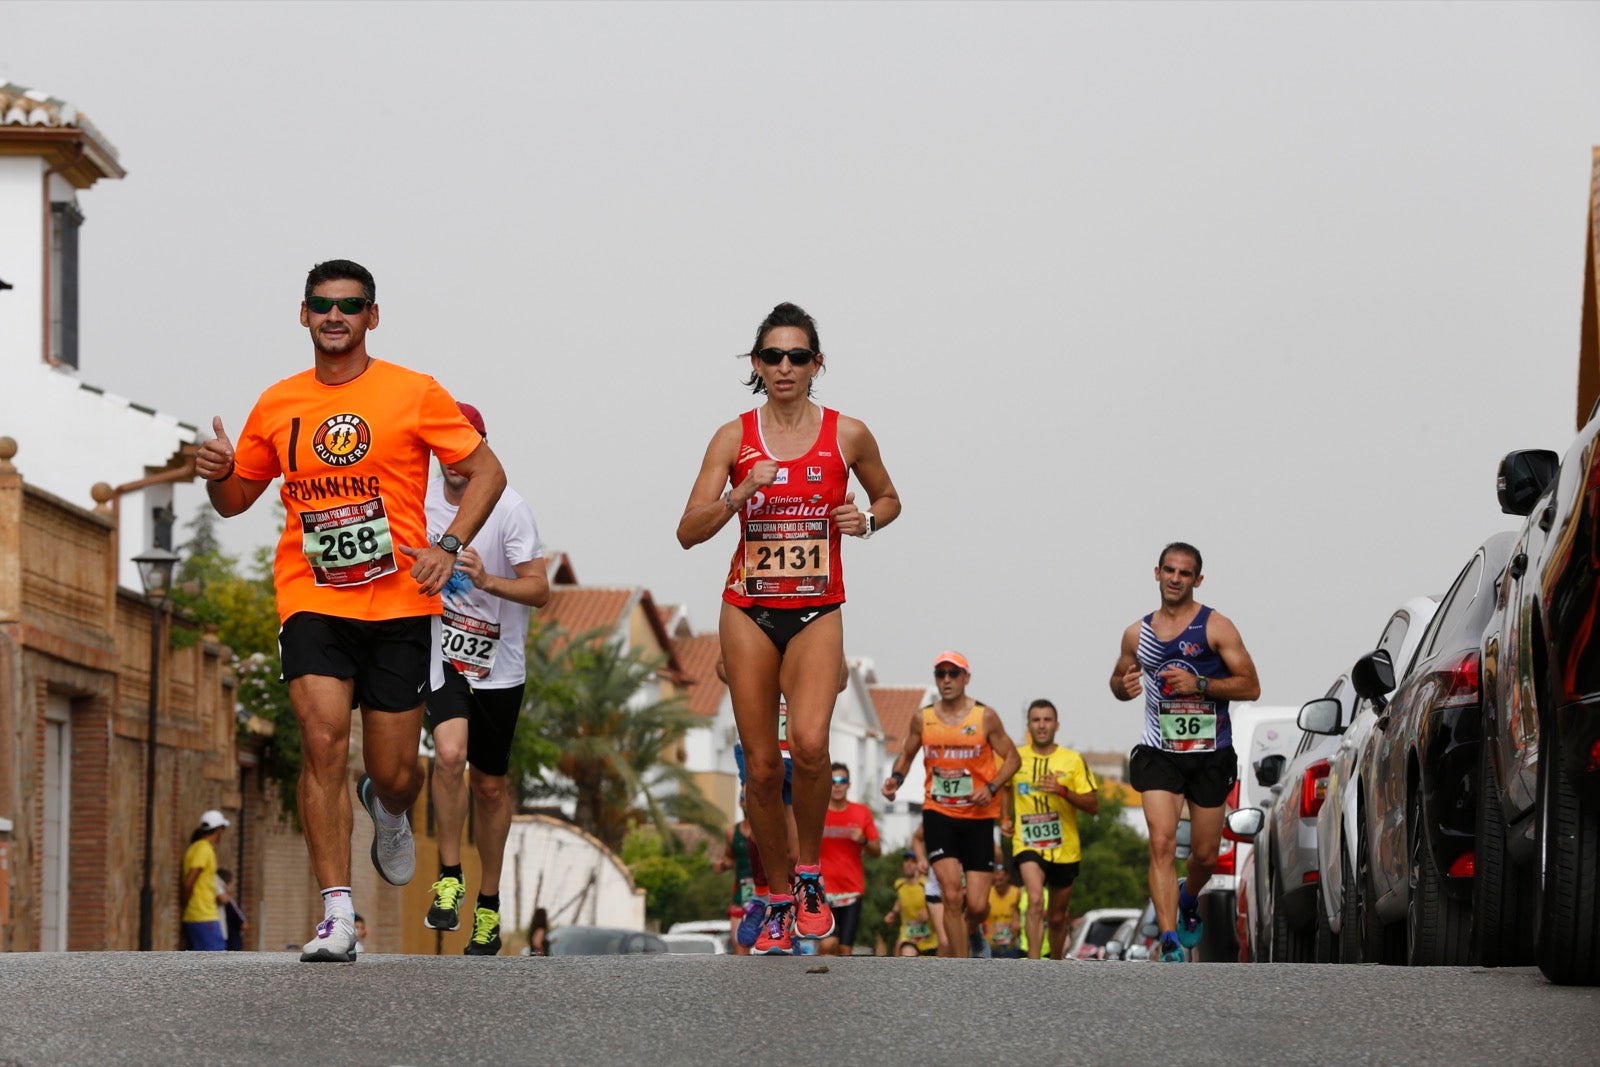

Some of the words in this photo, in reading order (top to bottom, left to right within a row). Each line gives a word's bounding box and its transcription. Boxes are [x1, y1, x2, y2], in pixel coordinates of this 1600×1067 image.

[327, 415, 360, 427] BEER
[316, 442, 368, 464] RUNNERS
[286, 476, 380, 501] RUNNING
[316, 511, 330, 522] GRAN
[330, 507, 350, 519] PREMIO
[351, 506, 360, 515] DE
[360, 501, 378, 513] FONDO
[763, 523, 776, 532] GRAN
[778, 523, 796, 531] PREMIO
[797, 522, 805, 531] DE
[805, 522, 822, 531] FONDO
[319, 527, 379, 562] 268
[756, 545, 820, 571] 2131
[441, 629, 492, 659] 3032
[1175, 717, 1200, 735] 36
[943, 780, 960, 793] 87
[1024, 823, 1060, 839] 1038
